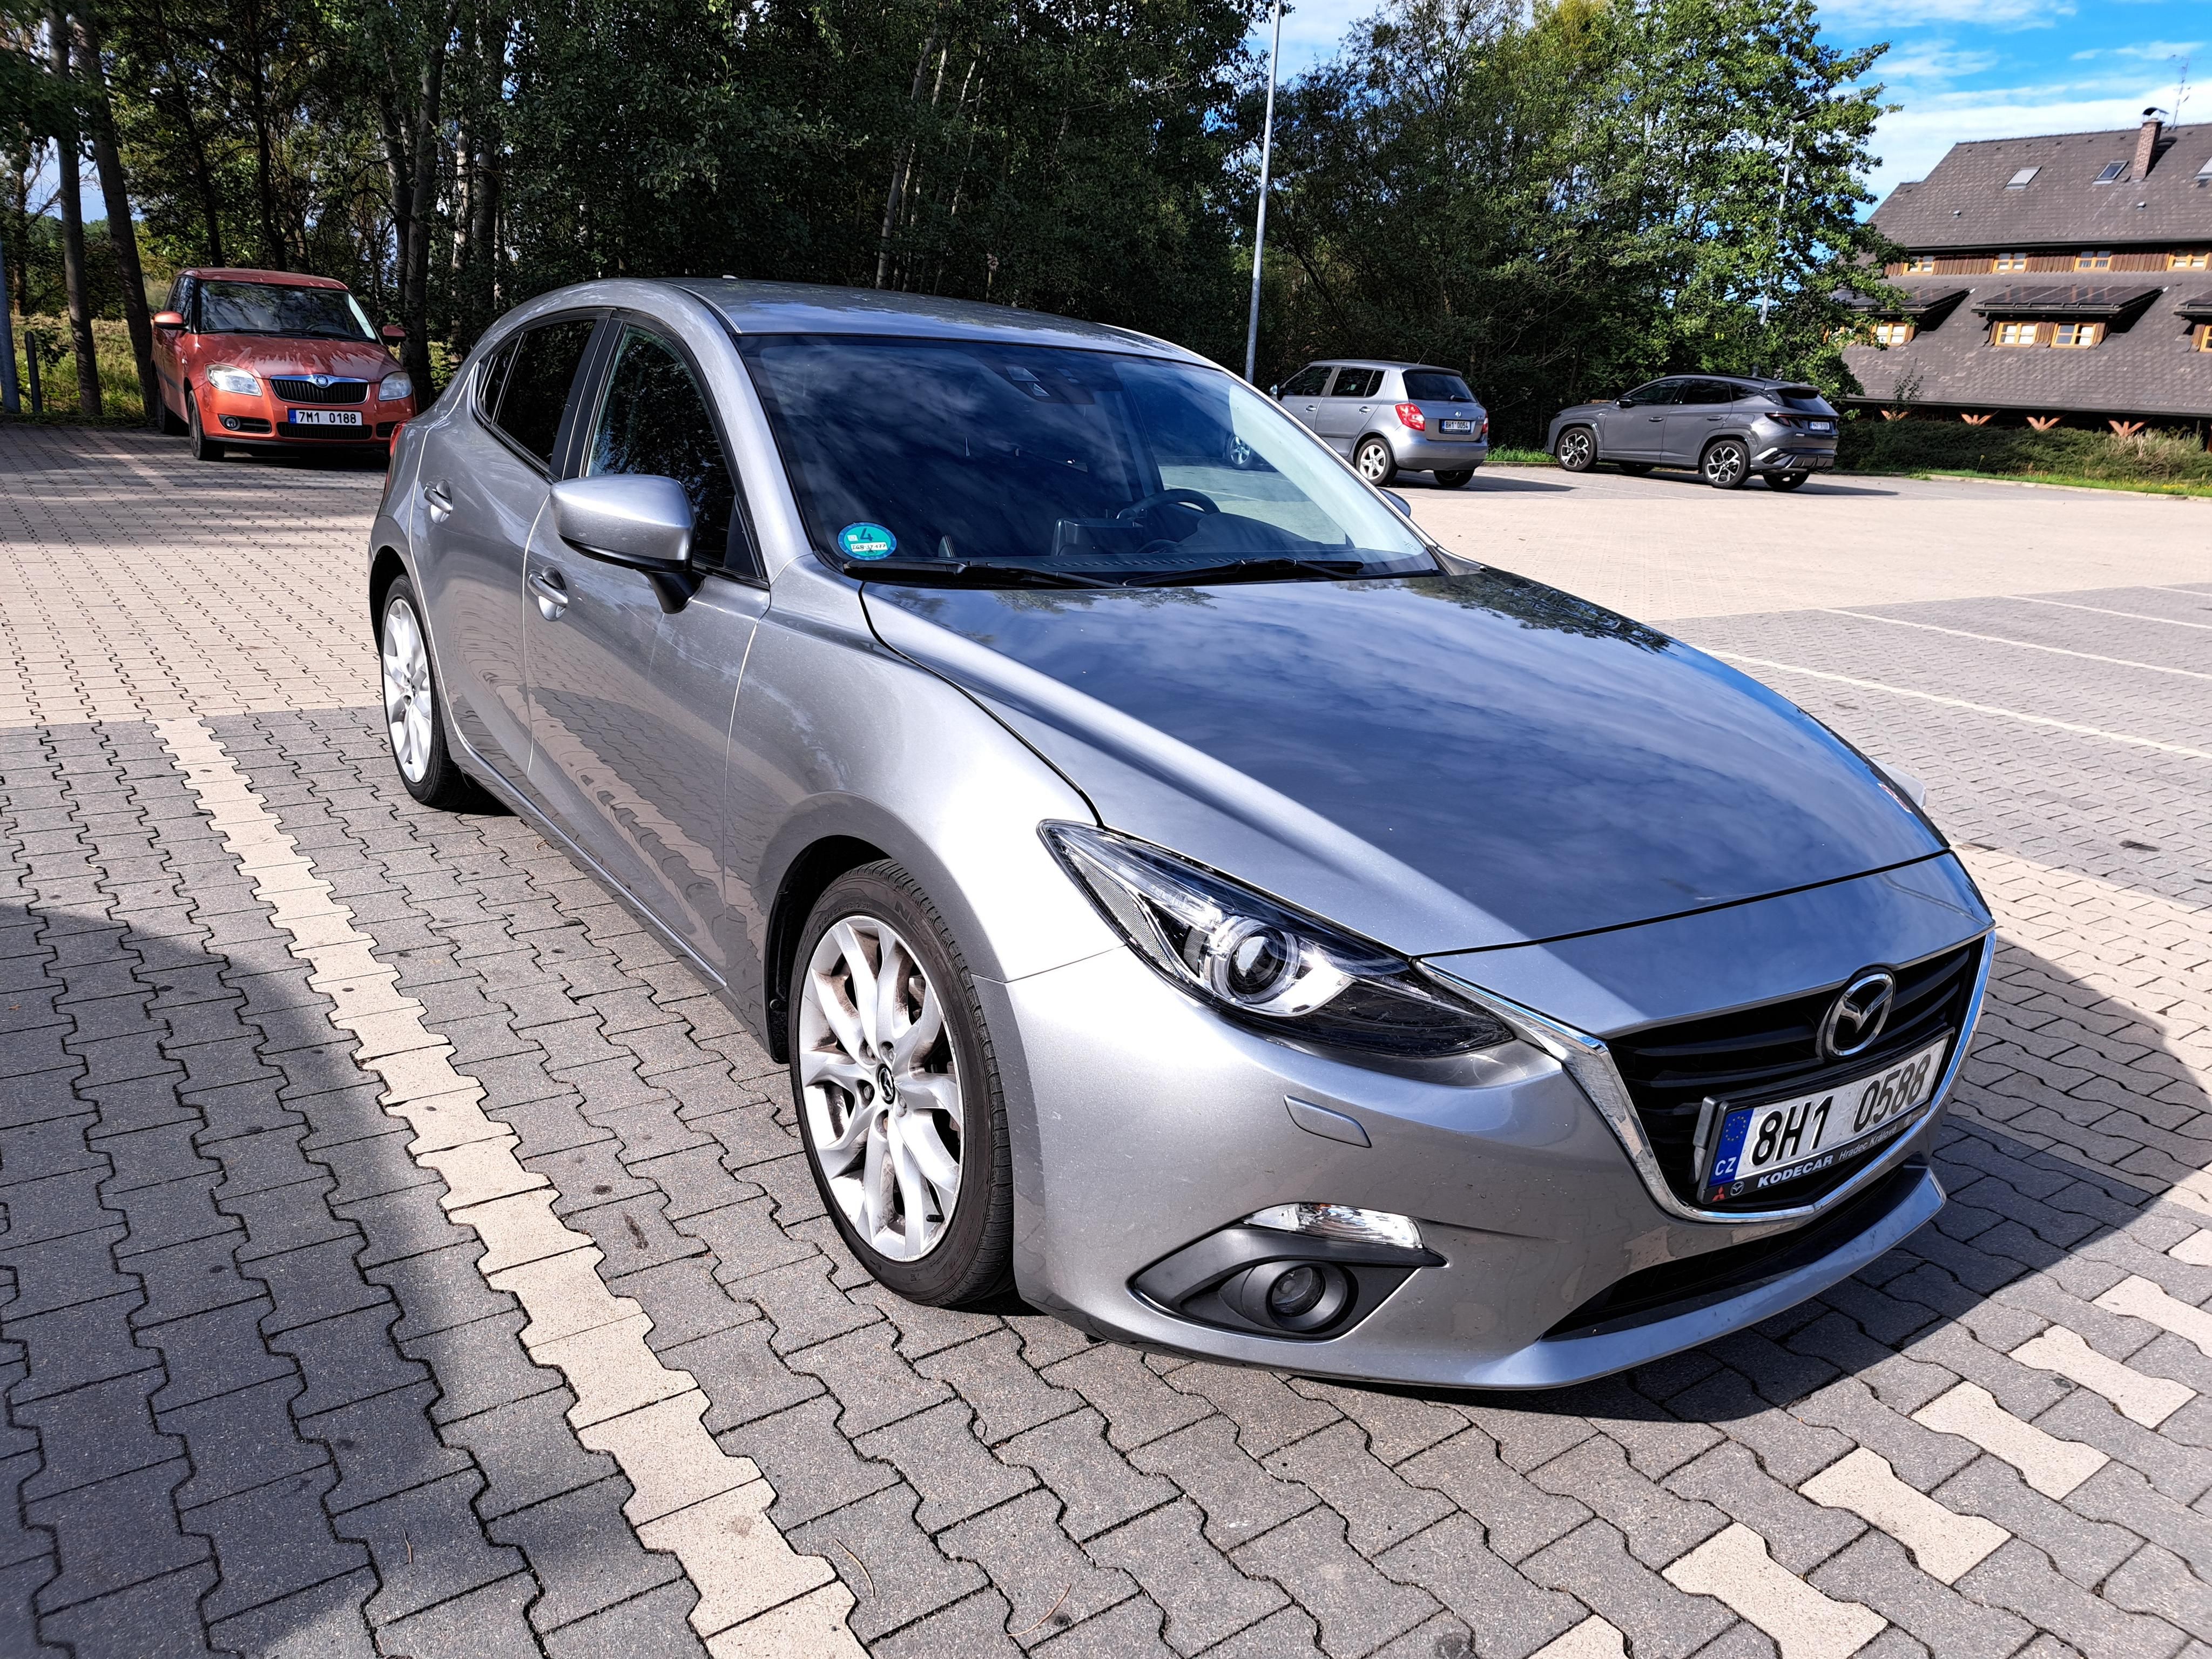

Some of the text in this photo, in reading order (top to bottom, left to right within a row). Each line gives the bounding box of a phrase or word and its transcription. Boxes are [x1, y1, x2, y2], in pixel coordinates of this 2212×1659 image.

[299, 412, 357, 424] 7M1 0188
[859, 528, 874, 541] 4
[1751, 1054, 1931, 1166] 8H1 0588
[1715, 1156, 1737, 1176] CZ
[1757, 1155, 1834, 1188] KODECAR
[1839, 1142, 1868, 1161] Hradec
